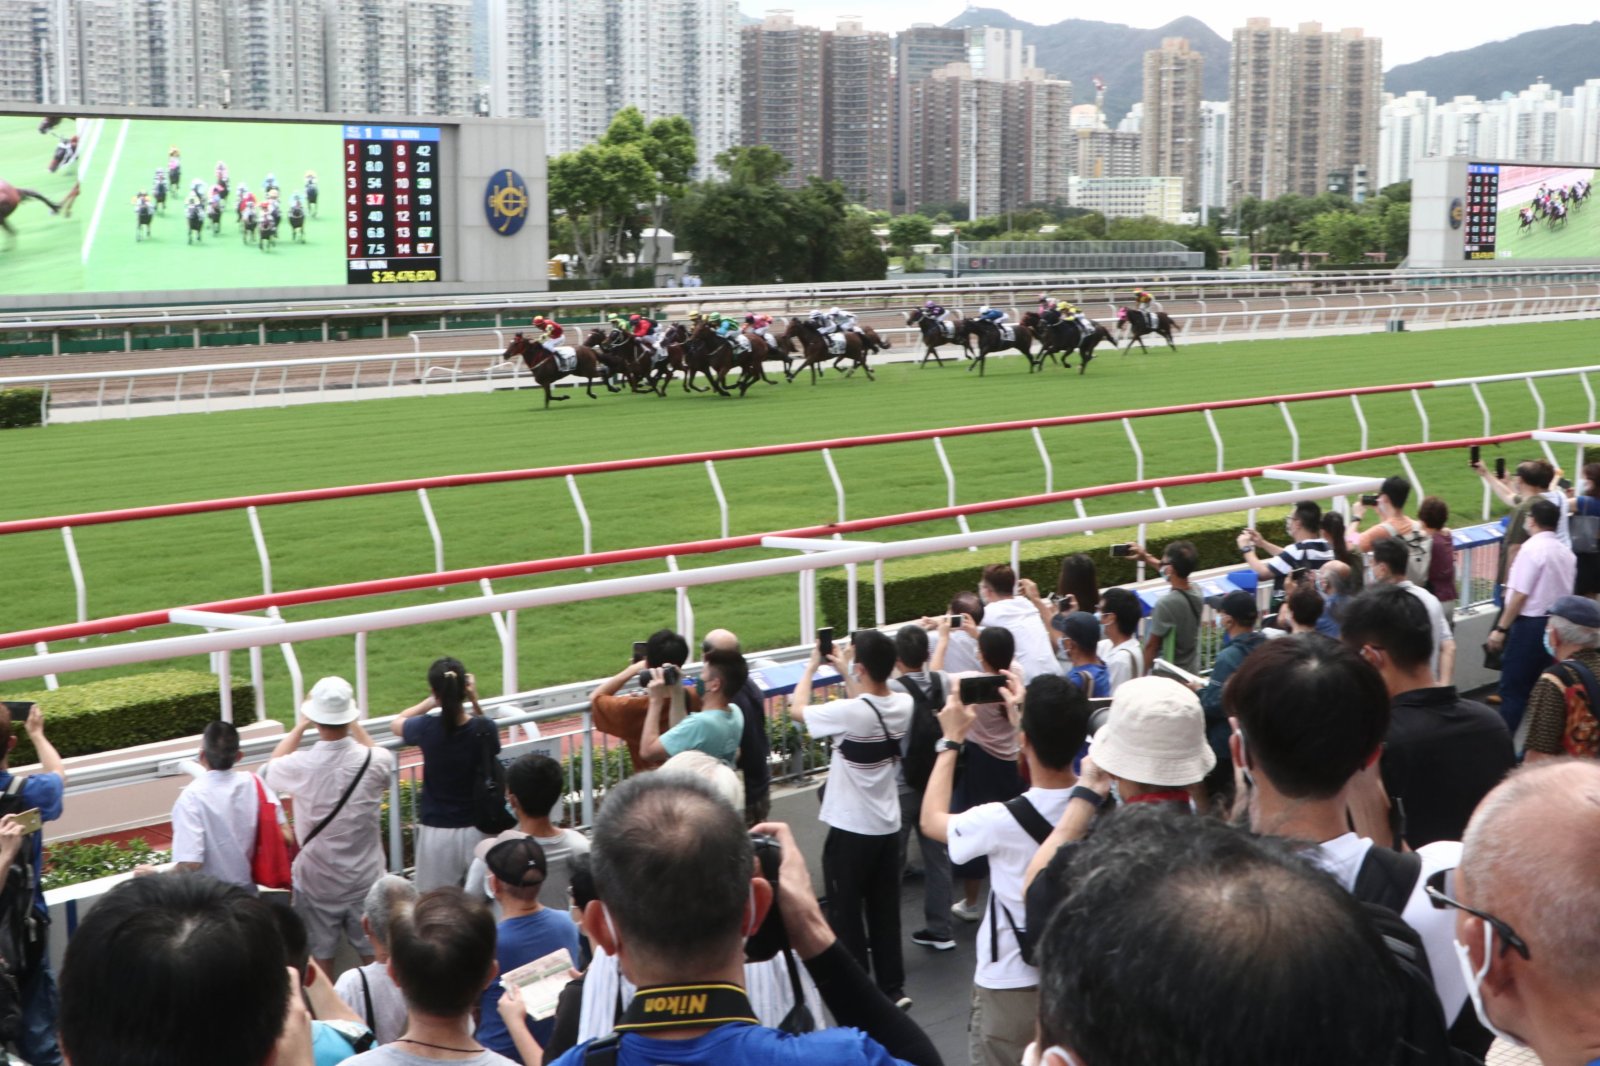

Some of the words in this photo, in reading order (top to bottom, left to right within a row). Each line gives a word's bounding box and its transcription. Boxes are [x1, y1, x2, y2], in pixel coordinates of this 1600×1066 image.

[347, 144, 355, 155] 1
[367, 144, 382, 156] 10
[396, 145, 406, 156] 8
[416, 145, 431, 156] 42
[347, 161, 356, 172] 2
[397, 161, 406, 173] 9
[416, 162, 431, 173] 21
[347, 177, 357, 189] 3
[367, 178, 383, 189] 54
[395, 178, 410, 189] 10
[347, 194, 357, 205] 4
[395, 195, 409, 205] 11
[348, 211, 358, 222] 5
[396, 211, 410, 222] 12
[418, 211, 432, 222] 11
[348, 227, 358, 239] 6
[396, 227, 411, 238] 13
[349, 244, 359, 255] 7
[396, 244, 411, 254] 14
[643, 993, 708, 1015] Nikon
